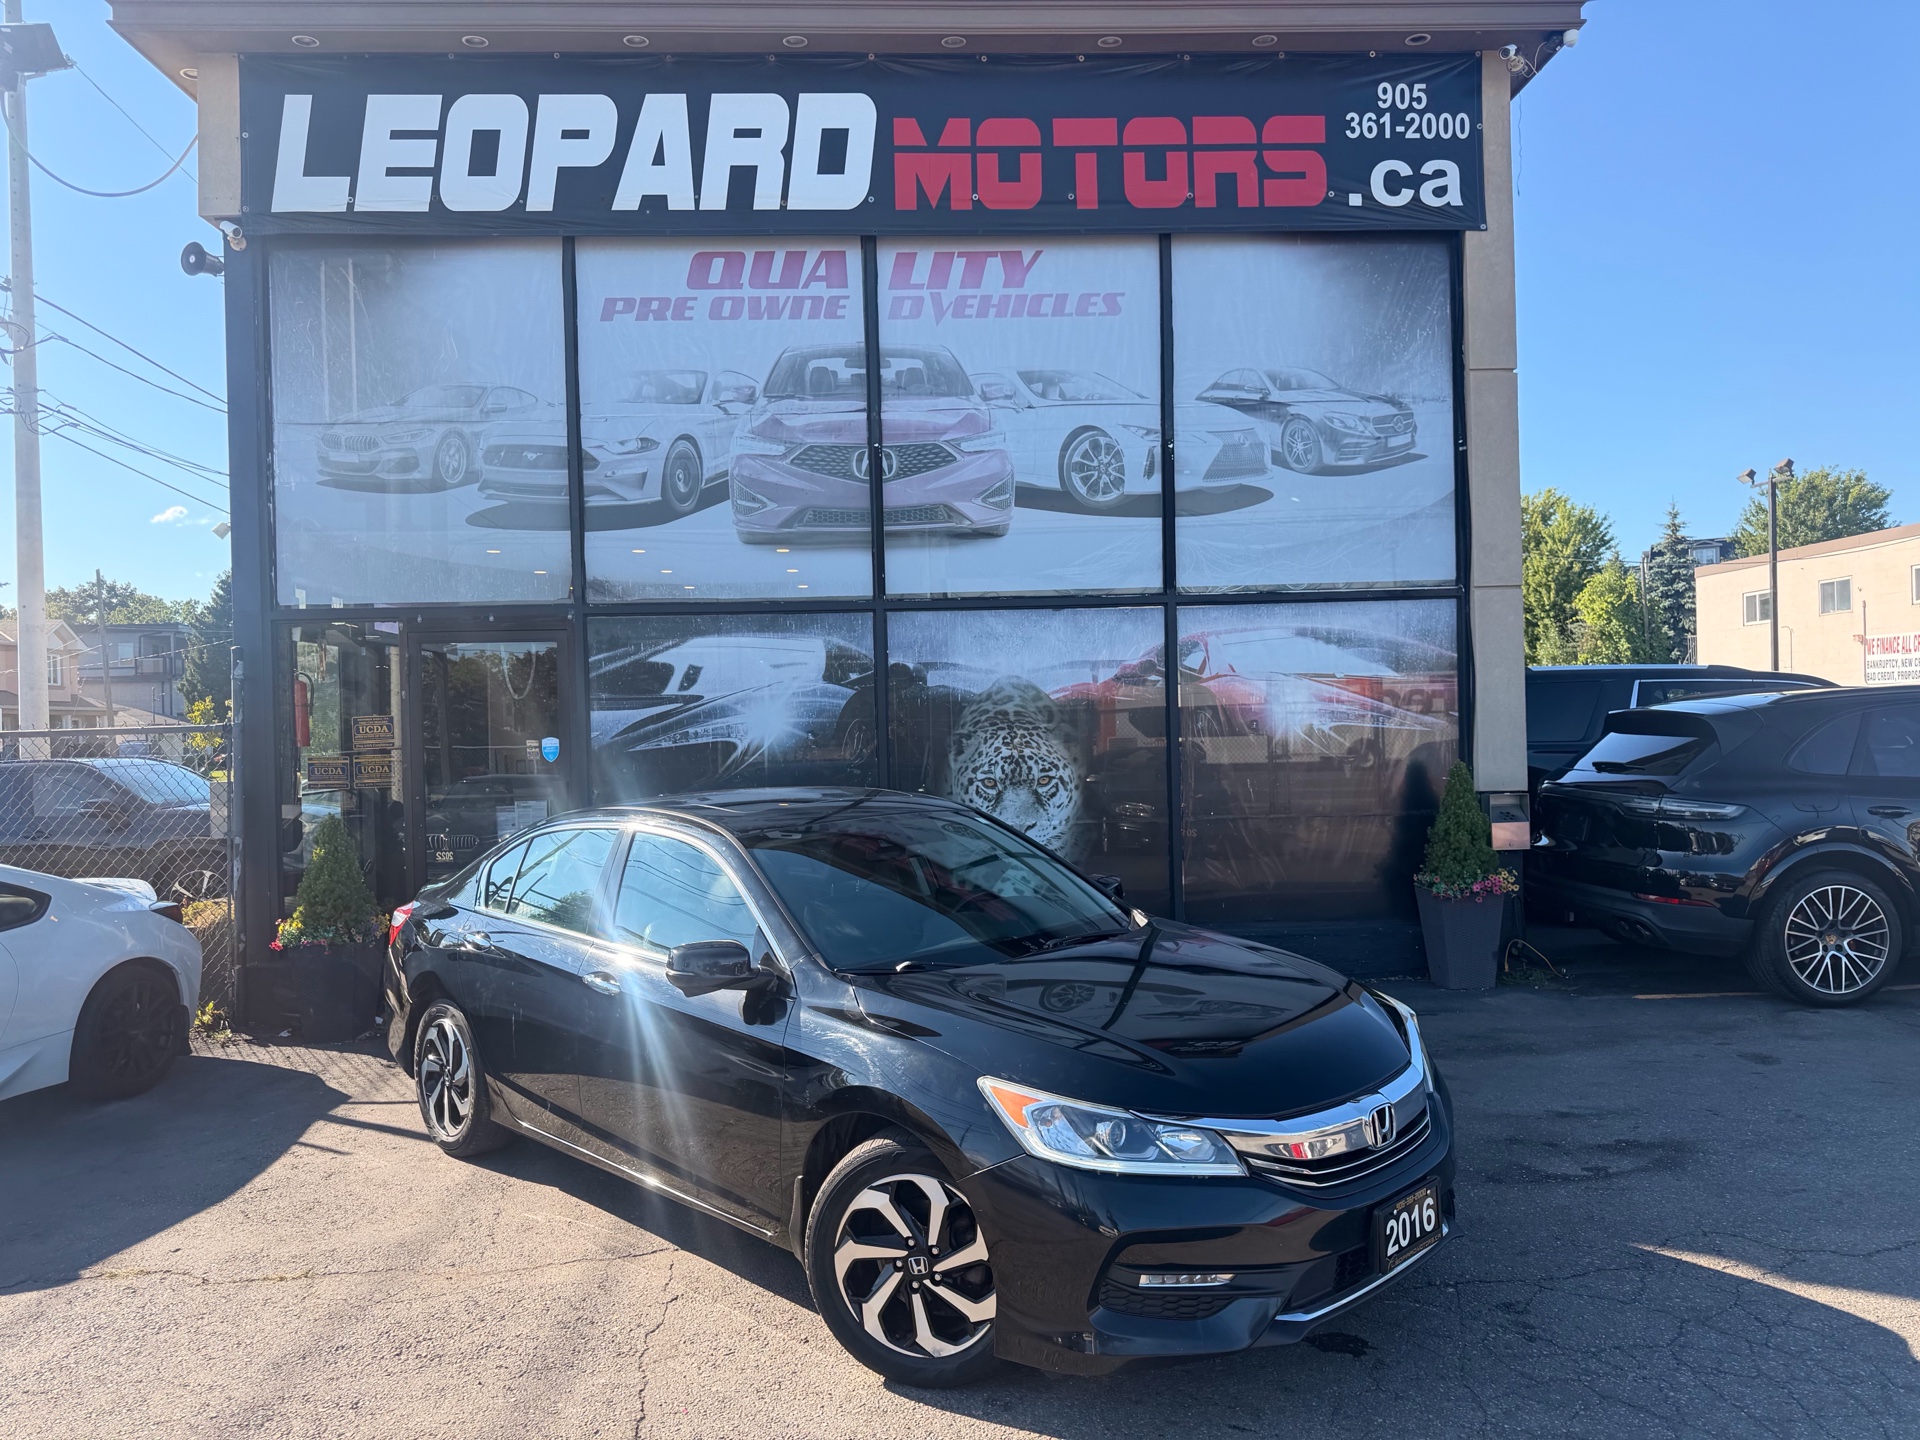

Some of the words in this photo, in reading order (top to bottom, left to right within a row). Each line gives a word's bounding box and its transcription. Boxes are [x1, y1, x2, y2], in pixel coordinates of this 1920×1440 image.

[1377, 82, 1427, 109] 905
[1345, 112, 1470, 139] 361-2000
[271, 93, 877, 212] LEOPARD
[893, 115, 1327, 211] MOTORS
[1348, 159, 1464, 207] .ca
[600, 296, 698, 322] PRE
[1877, 636, 1899, 655] FINANCE
[1902, 634, 1912, 654] ALL
[1901, 658, 1913, 668] NEW
[1867, 672, 1876, 681] BAD
[359, 725, 389, 734] UCDA
[314, 767, 343, 775] UCDA
[361, 765, 390, 773] UCDA
[1387, 1198, 1435, 1257] 2016
